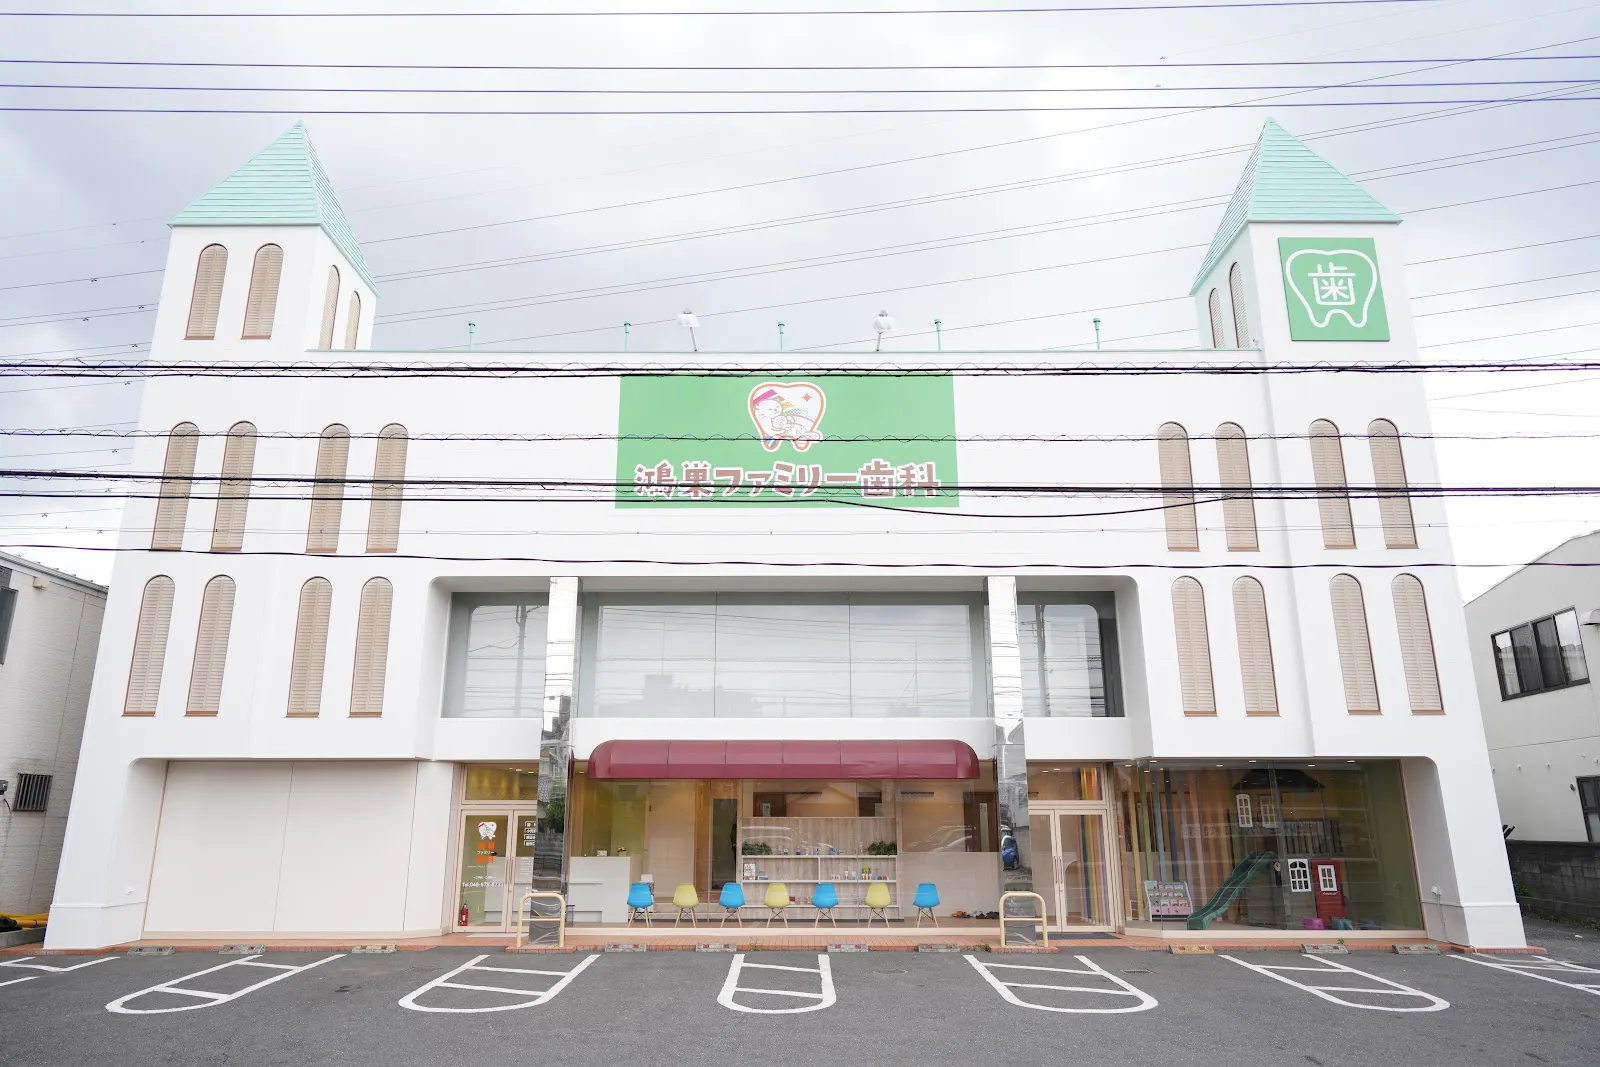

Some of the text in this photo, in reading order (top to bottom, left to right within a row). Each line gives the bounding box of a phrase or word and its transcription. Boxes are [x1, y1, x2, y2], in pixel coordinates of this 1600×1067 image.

[1308, 261, 1356, 305] 歯
[634, 459, 940, 498] 鴻巣ファミリー歯科
